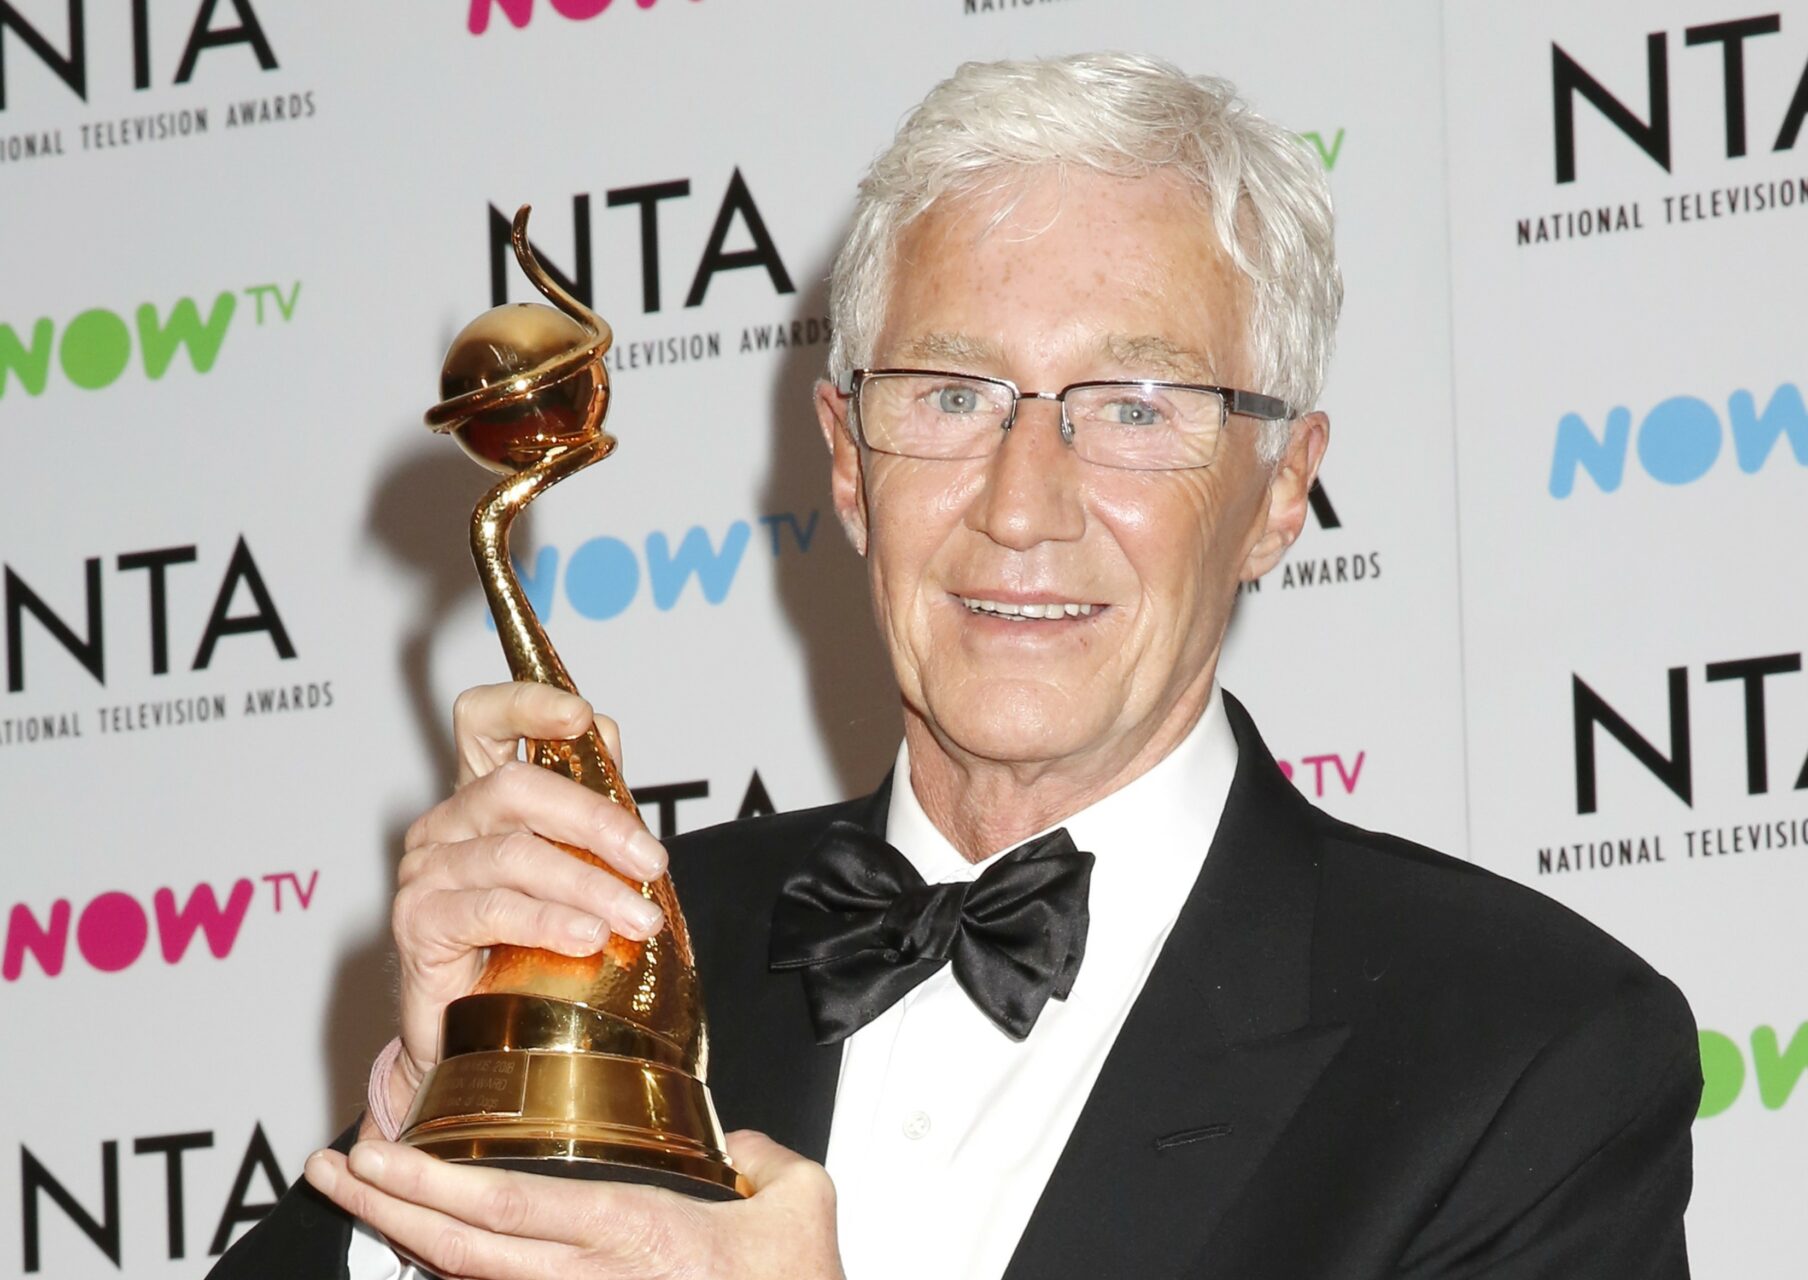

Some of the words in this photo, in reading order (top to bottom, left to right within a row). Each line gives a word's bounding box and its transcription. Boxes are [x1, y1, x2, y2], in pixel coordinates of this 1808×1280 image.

[80, 108, 208, 149] TELEVISION
[226, 91, 315, 128] AWARDS
[489, 164, 797, 316] NTA
[1517, 203, 1643, 246] NATIONAL
[0, 291, 237, 399] NOW
[244, 281, 301, 325] TV
[740, 317, 833, 354] AWARDS
[757, 511, 818, 557] TV
[1282, 552, 1381, 590] AWARDS
[4, 534, 298, 692] NTA
[0, 713, 81, 745] TIONAL
[98, 695, 226, 734] TELEVISION
[244, 681, 334, 716] AWARDS
[1572, 652, 1808, 815] NT
[1302, 751, 1365, 797] TV
[1538, 836, 1665, 875] NATIONAL
[2, 878, 254, 981] NOW
[263, 870, 319, 912] TV
[20, 1120, 291, 1273] NTA
